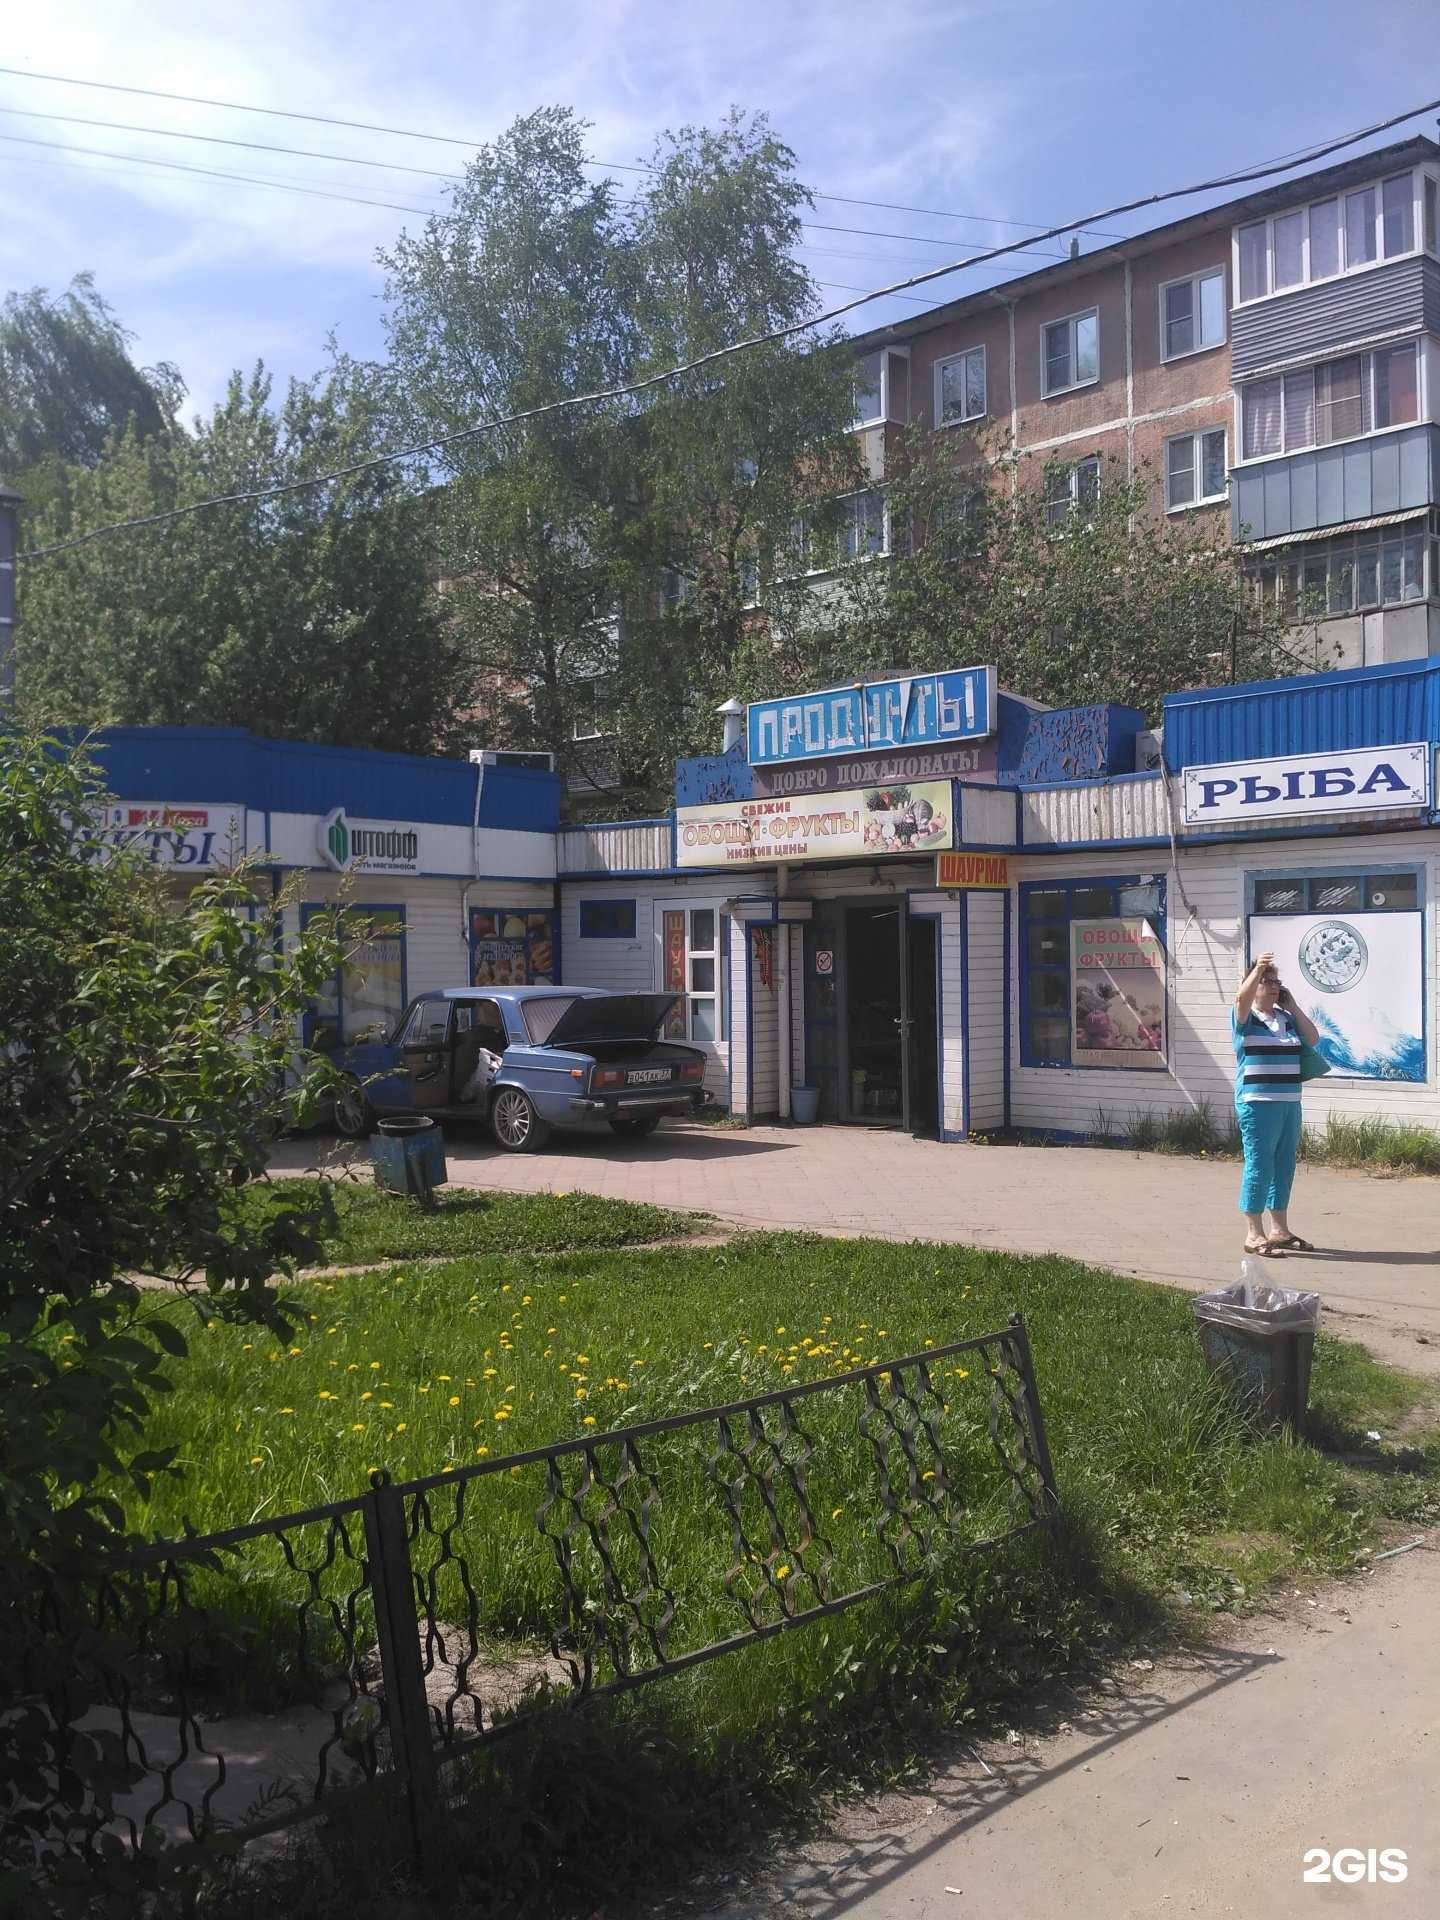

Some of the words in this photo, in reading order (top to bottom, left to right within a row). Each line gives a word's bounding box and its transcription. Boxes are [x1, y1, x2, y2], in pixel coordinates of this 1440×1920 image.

[771, 767, 827, 795] ДОБРО
[1199, 763, 1411, 808] РЫБА
[741, 801, 791, 816] СВЕЖИЕ
[768, 810, 860, 840] ФРУКТЫ
[726, 847, 773, 860] НИЗКИЕ
[774, 843, 808, 857] ЦЕНЫ
[940, 855, 1008, 884] ШАУРМА
[1080, 951, 1156, 968] ФРУКТЫ
